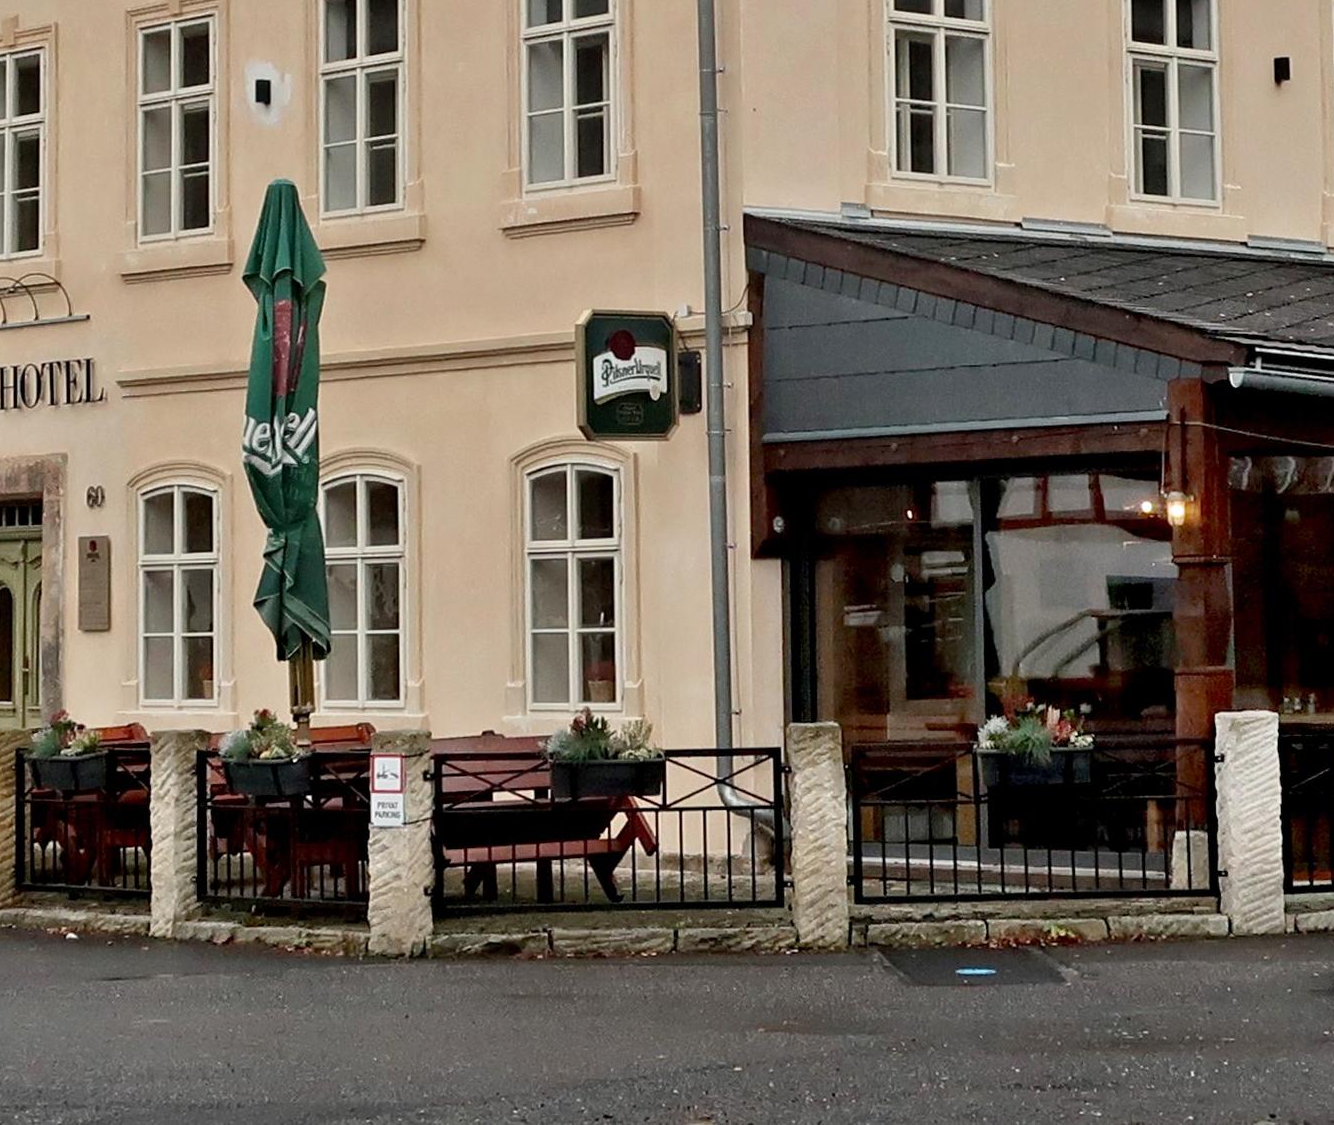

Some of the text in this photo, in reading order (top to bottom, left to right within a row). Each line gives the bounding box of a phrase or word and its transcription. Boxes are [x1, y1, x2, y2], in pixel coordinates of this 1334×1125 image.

[601, 358, 662, 387] Pilsner Urquell
[86, 486, 105, 508] 60
